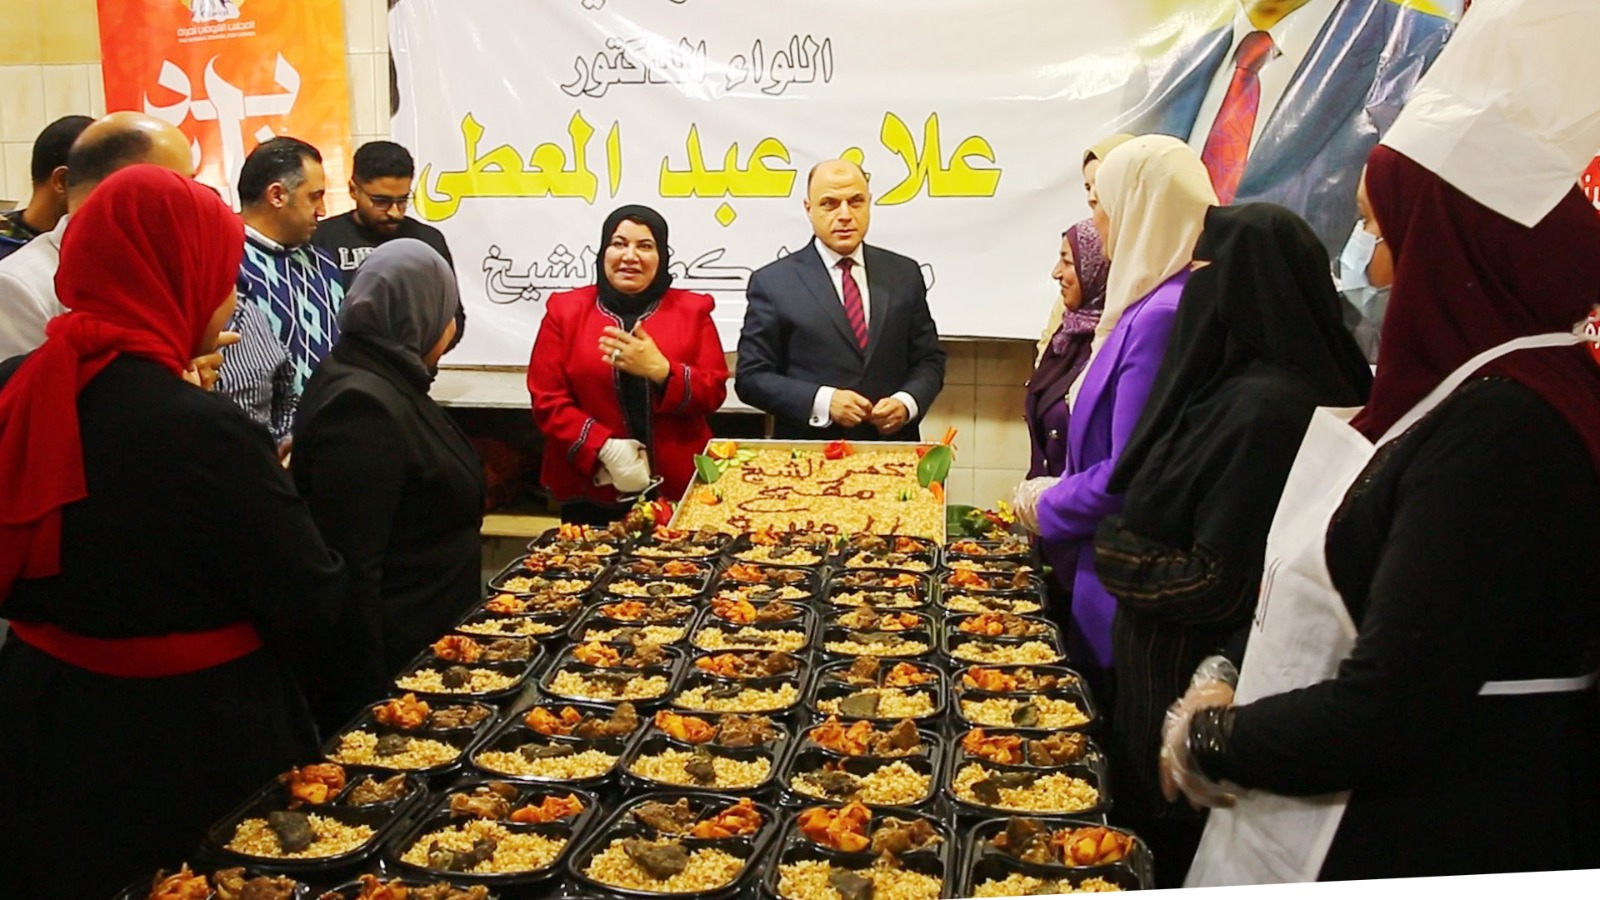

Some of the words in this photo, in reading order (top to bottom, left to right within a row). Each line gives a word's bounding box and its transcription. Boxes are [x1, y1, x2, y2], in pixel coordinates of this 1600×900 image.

[724, 34, 834, 96] اللواء
[658, 121, 798, 228] عبد
[482, 243, 600, 305] لشيخ
[666, 242, 756, 292] كف
